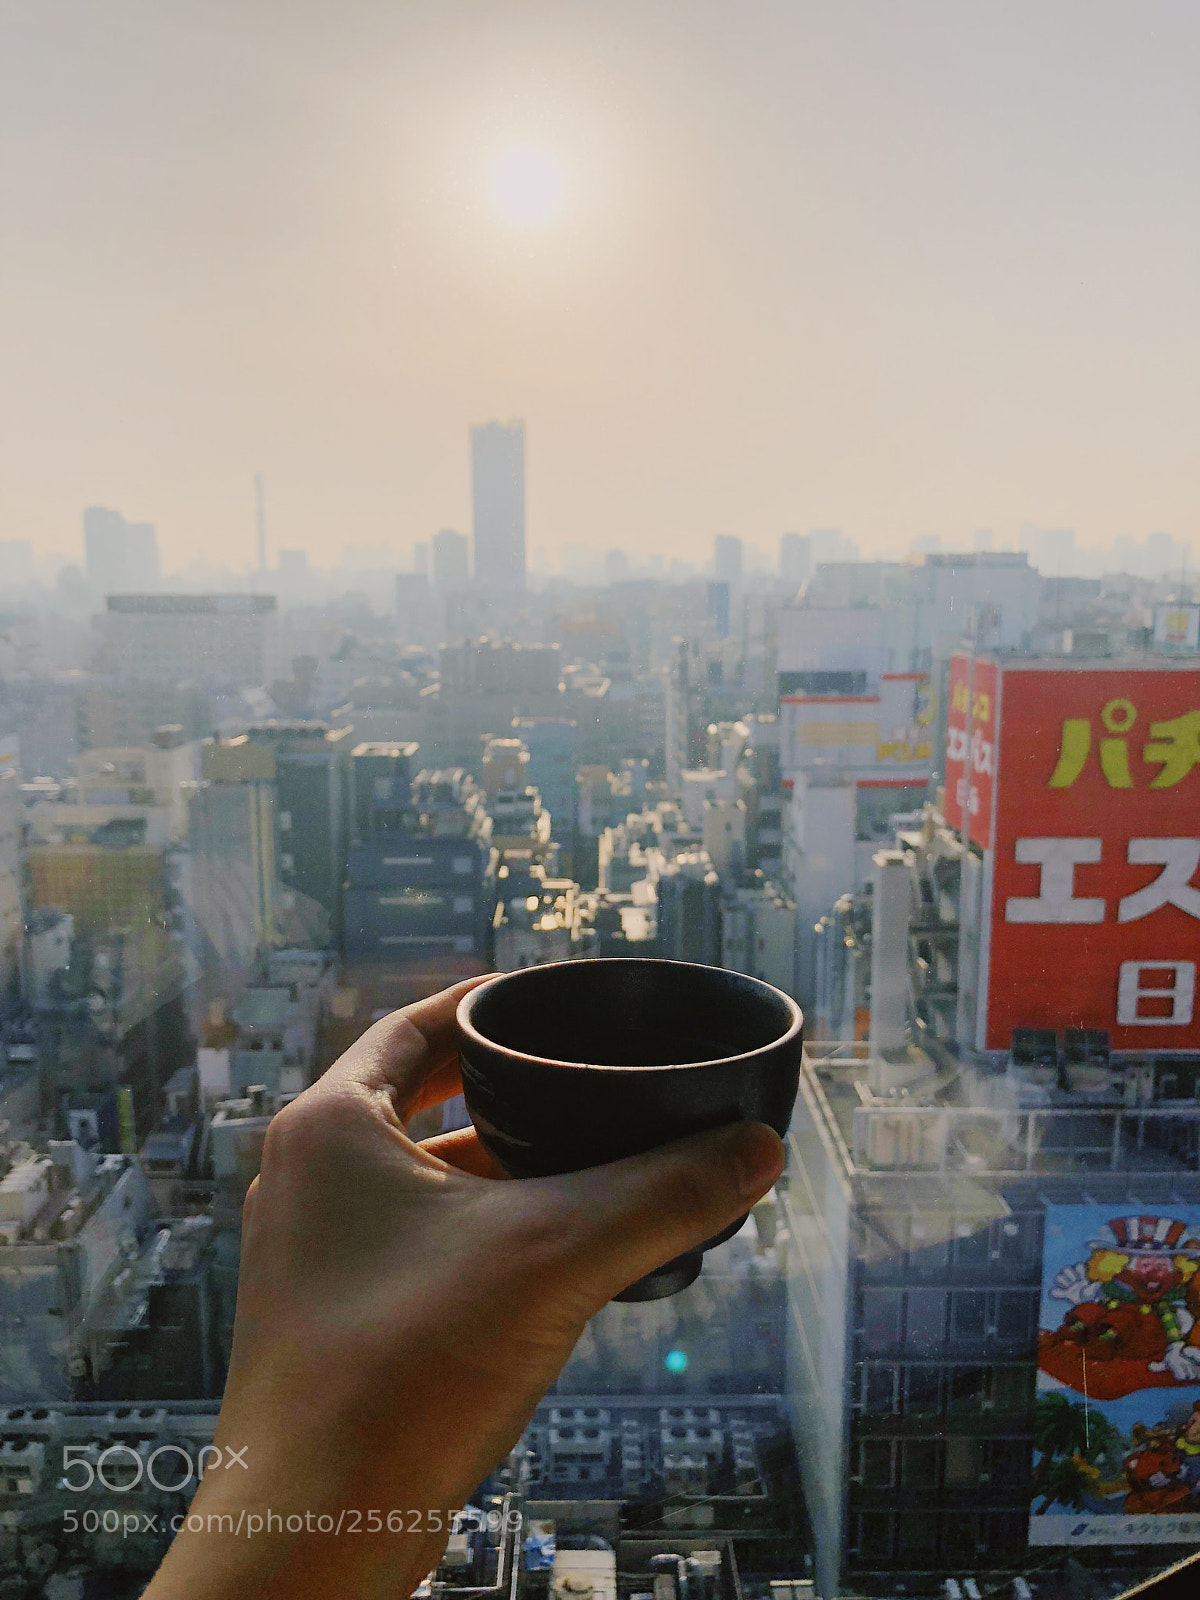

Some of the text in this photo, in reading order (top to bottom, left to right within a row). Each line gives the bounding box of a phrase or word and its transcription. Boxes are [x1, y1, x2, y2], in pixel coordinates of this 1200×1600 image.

[1048, 700, 1200, 788] パチ
[1004, 837, 1200, 924] エス
[1116, 960, 1196, 1026] 日
